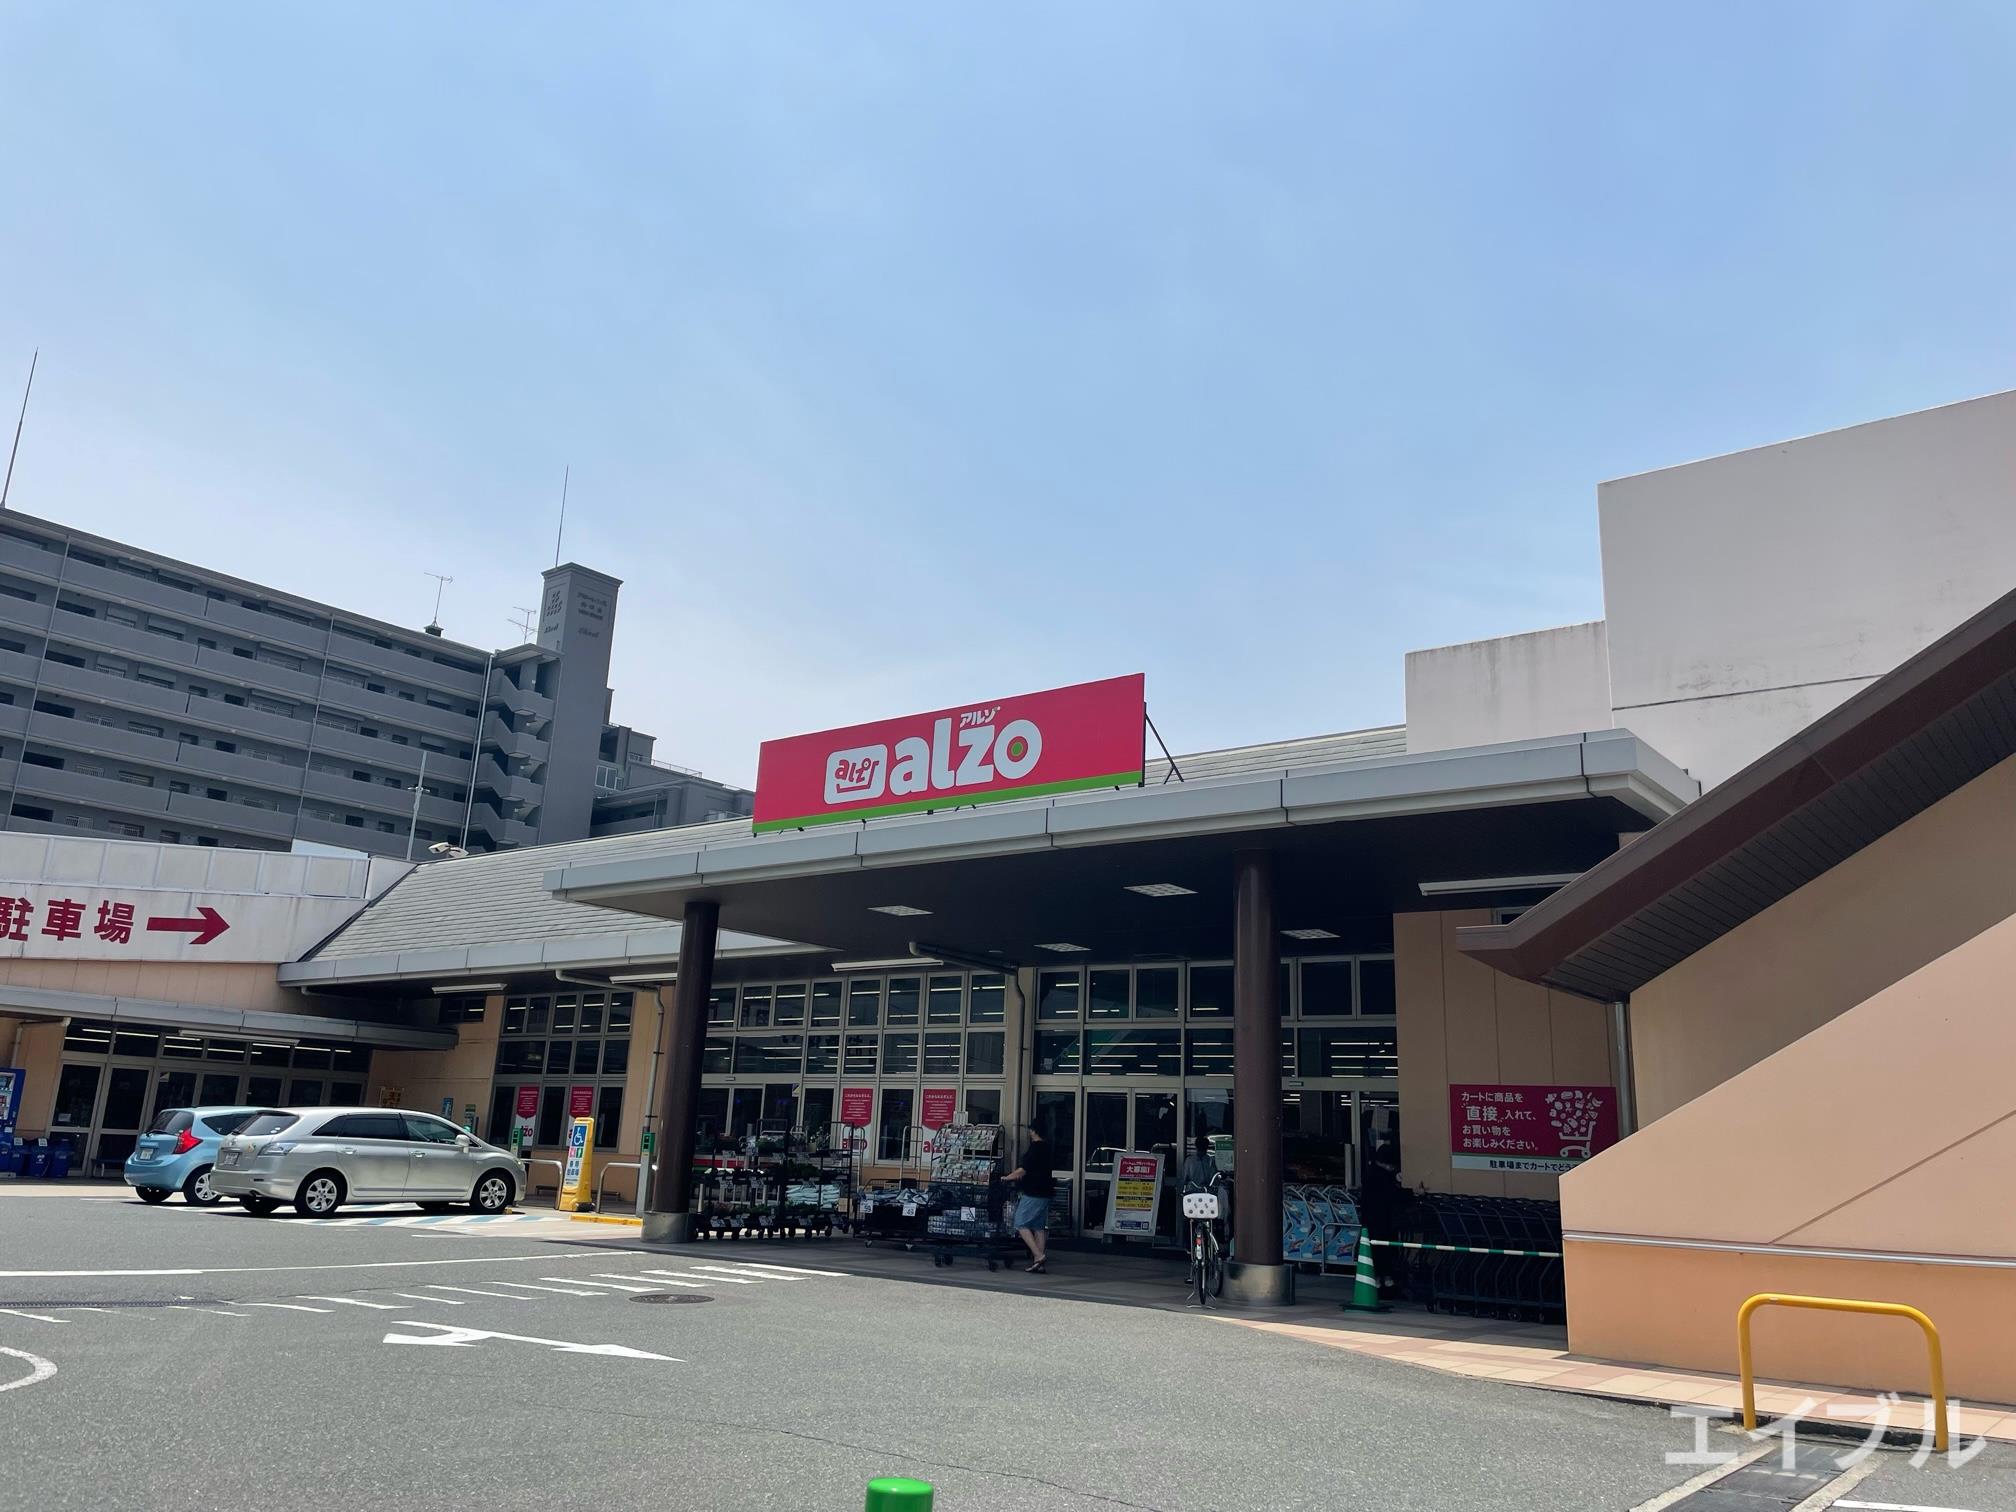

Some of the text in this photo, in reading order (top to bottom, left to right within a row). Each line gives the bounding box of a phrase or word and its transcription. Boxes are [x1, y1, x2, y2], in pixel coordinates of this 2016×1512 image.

[960, 705, 1001, 728] アルゾ
[889, 717, 1043, 796] alzo
[0, 897, 136, 945] 駐車場
[1461, 1092, 1524, 1103] カートに商品を
[1462, 1125, 1511, 1136] お買い物を
[1463, 1138, 1539, 1151] お楽しみください。
